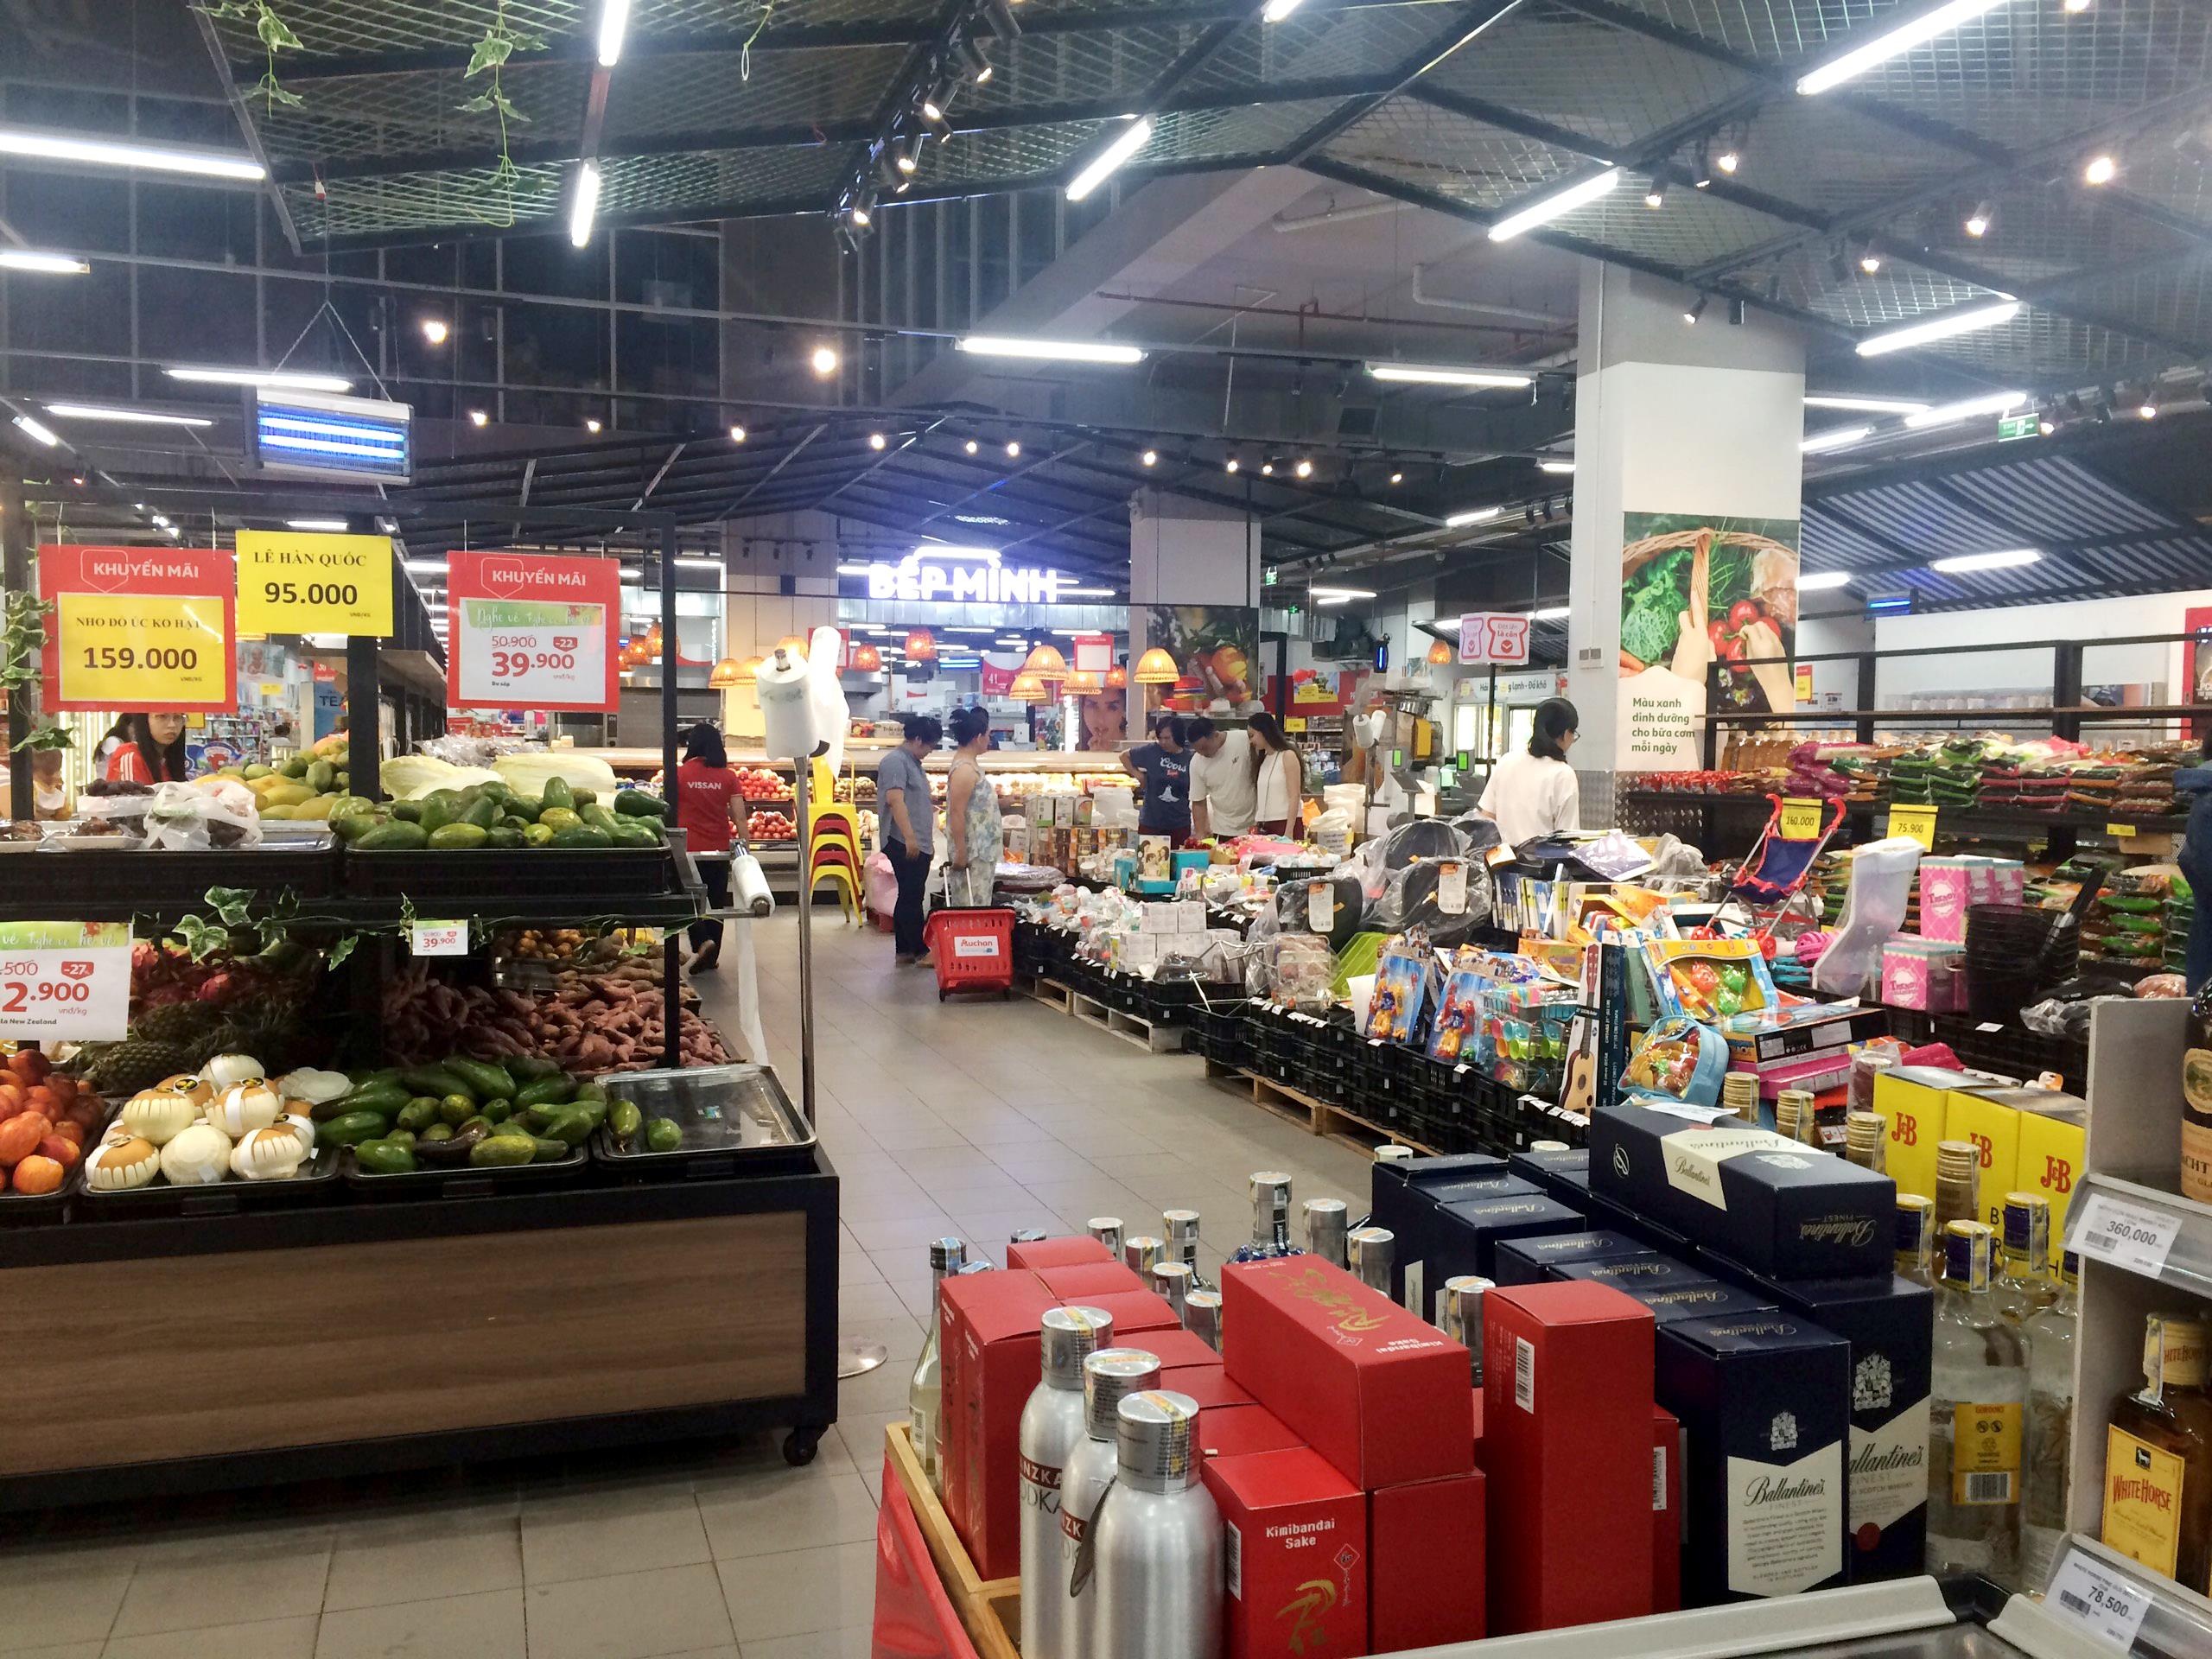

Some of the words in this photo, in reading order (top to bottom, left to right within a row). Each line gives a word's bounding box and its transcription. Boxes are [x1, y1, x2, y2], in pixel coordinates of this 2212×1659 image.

[254, 549, 274, 564] LÊ
[280, 549, 315, 564] HÀN
[93, 558, 163, 577] KHUYẾN
[167, 563, 200, 578] MÃI
[492, 567, 556, 585] KHUYẾN
[557, 571, 586, 587] MÃI
[869, 556, 948, 600] BẾP
[953, 556, 1058, 603] MÌNH
[264, 582, 358, 606] 95.000
[76, 617, 105, 627] NHO
[492, 635, 537, 650] 50.900
[83, 646, 198, 671] 159.000
[492, 652, 575, 677] 39.900
[1632, 697, 1655, 708] Màu
[1656, 697, 1681, 708] xanh
[1632, 712, 1655, 722] dinh
[1657, 712, 1689, 726] dưỡng
[1631, 727, 1649, 737] cho
[1652, 727, 1672, 737] bữa
[1631, 740, 1650, 752] mỗi
[1653, 742, 1677, 755] ngày
[1160, 757, 1186, 772] Coors
[688, 781, 721, 790] VISSAN
[1786, 816, 1815, 826] 160.000
[1897, 823, 1923, 834] 75.900
[423, 938, 456, 949] 39.900
[961, 938, 993, 947] Auchan
[1891, 1111, 1917, 1147] J&B
[1970, 1132, 1993, 1168] JB
[1674, 1155, 1712, 1187] Ballantine's
[2040, 1154, 2072, 1194] J&B
[2107, 1220, 2158, 1246] 360,000
[1376, 1339, 1445, 1355] Kimibandai
[1849, 1441, 1925, 1475] allantine's
[1021, 1459, 1063, 1485] NZKA
[1744, 1475, 1827, 1508] Ballantine's
[2113, 1473, 2141, 1504] WHITE
[2141, 1478, 2172, 1511] HORSE
[1266, 1518, 1335, 1538] Kimibandai
[1285, 1535, 1317, 1549] Sake
[2088, 1586, 2130, 1618] 78,500
